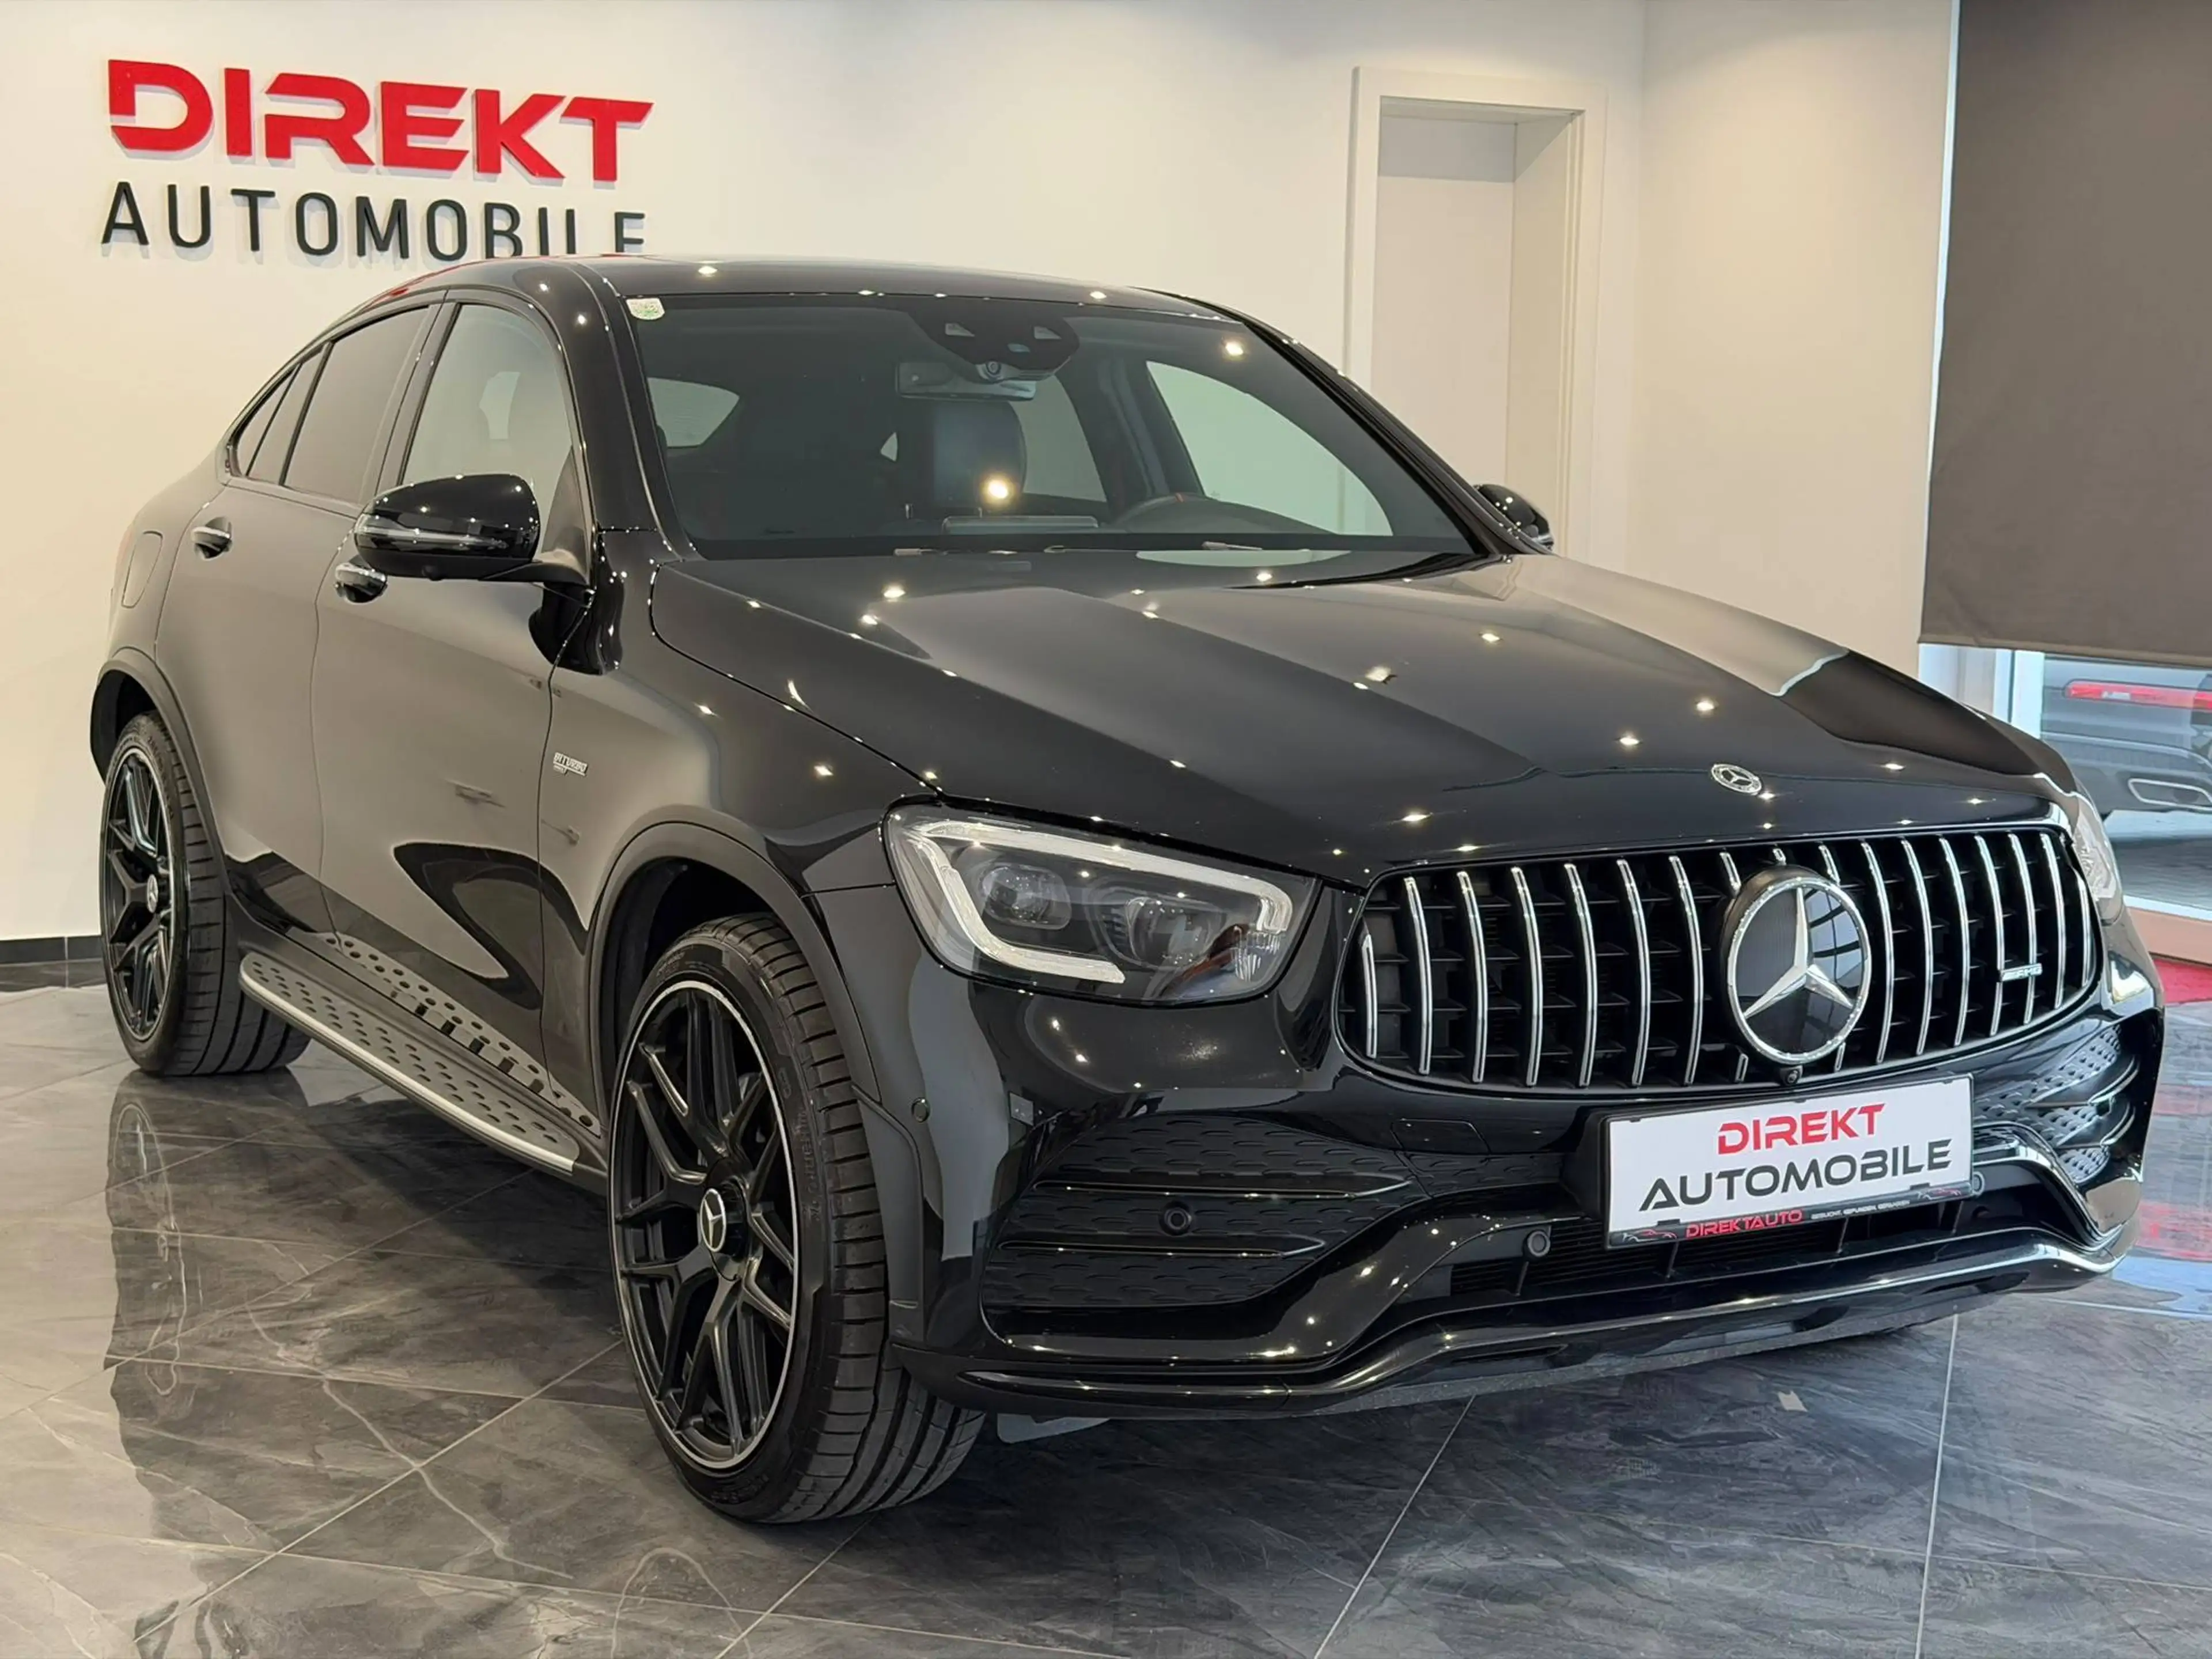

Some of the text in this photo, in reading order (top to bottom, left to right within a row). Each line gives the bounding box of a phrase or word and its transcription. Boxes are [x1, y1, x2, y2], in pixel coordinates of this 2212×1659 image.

[108, 59, 653, 183] DIREKT
[1718, 1103, 1885, 1154] DIREKT
[1638, 1138, 1951, 1211] AUTOMOBILE
[1686, 1210, 1803, 1238] DIREKTAUTO
